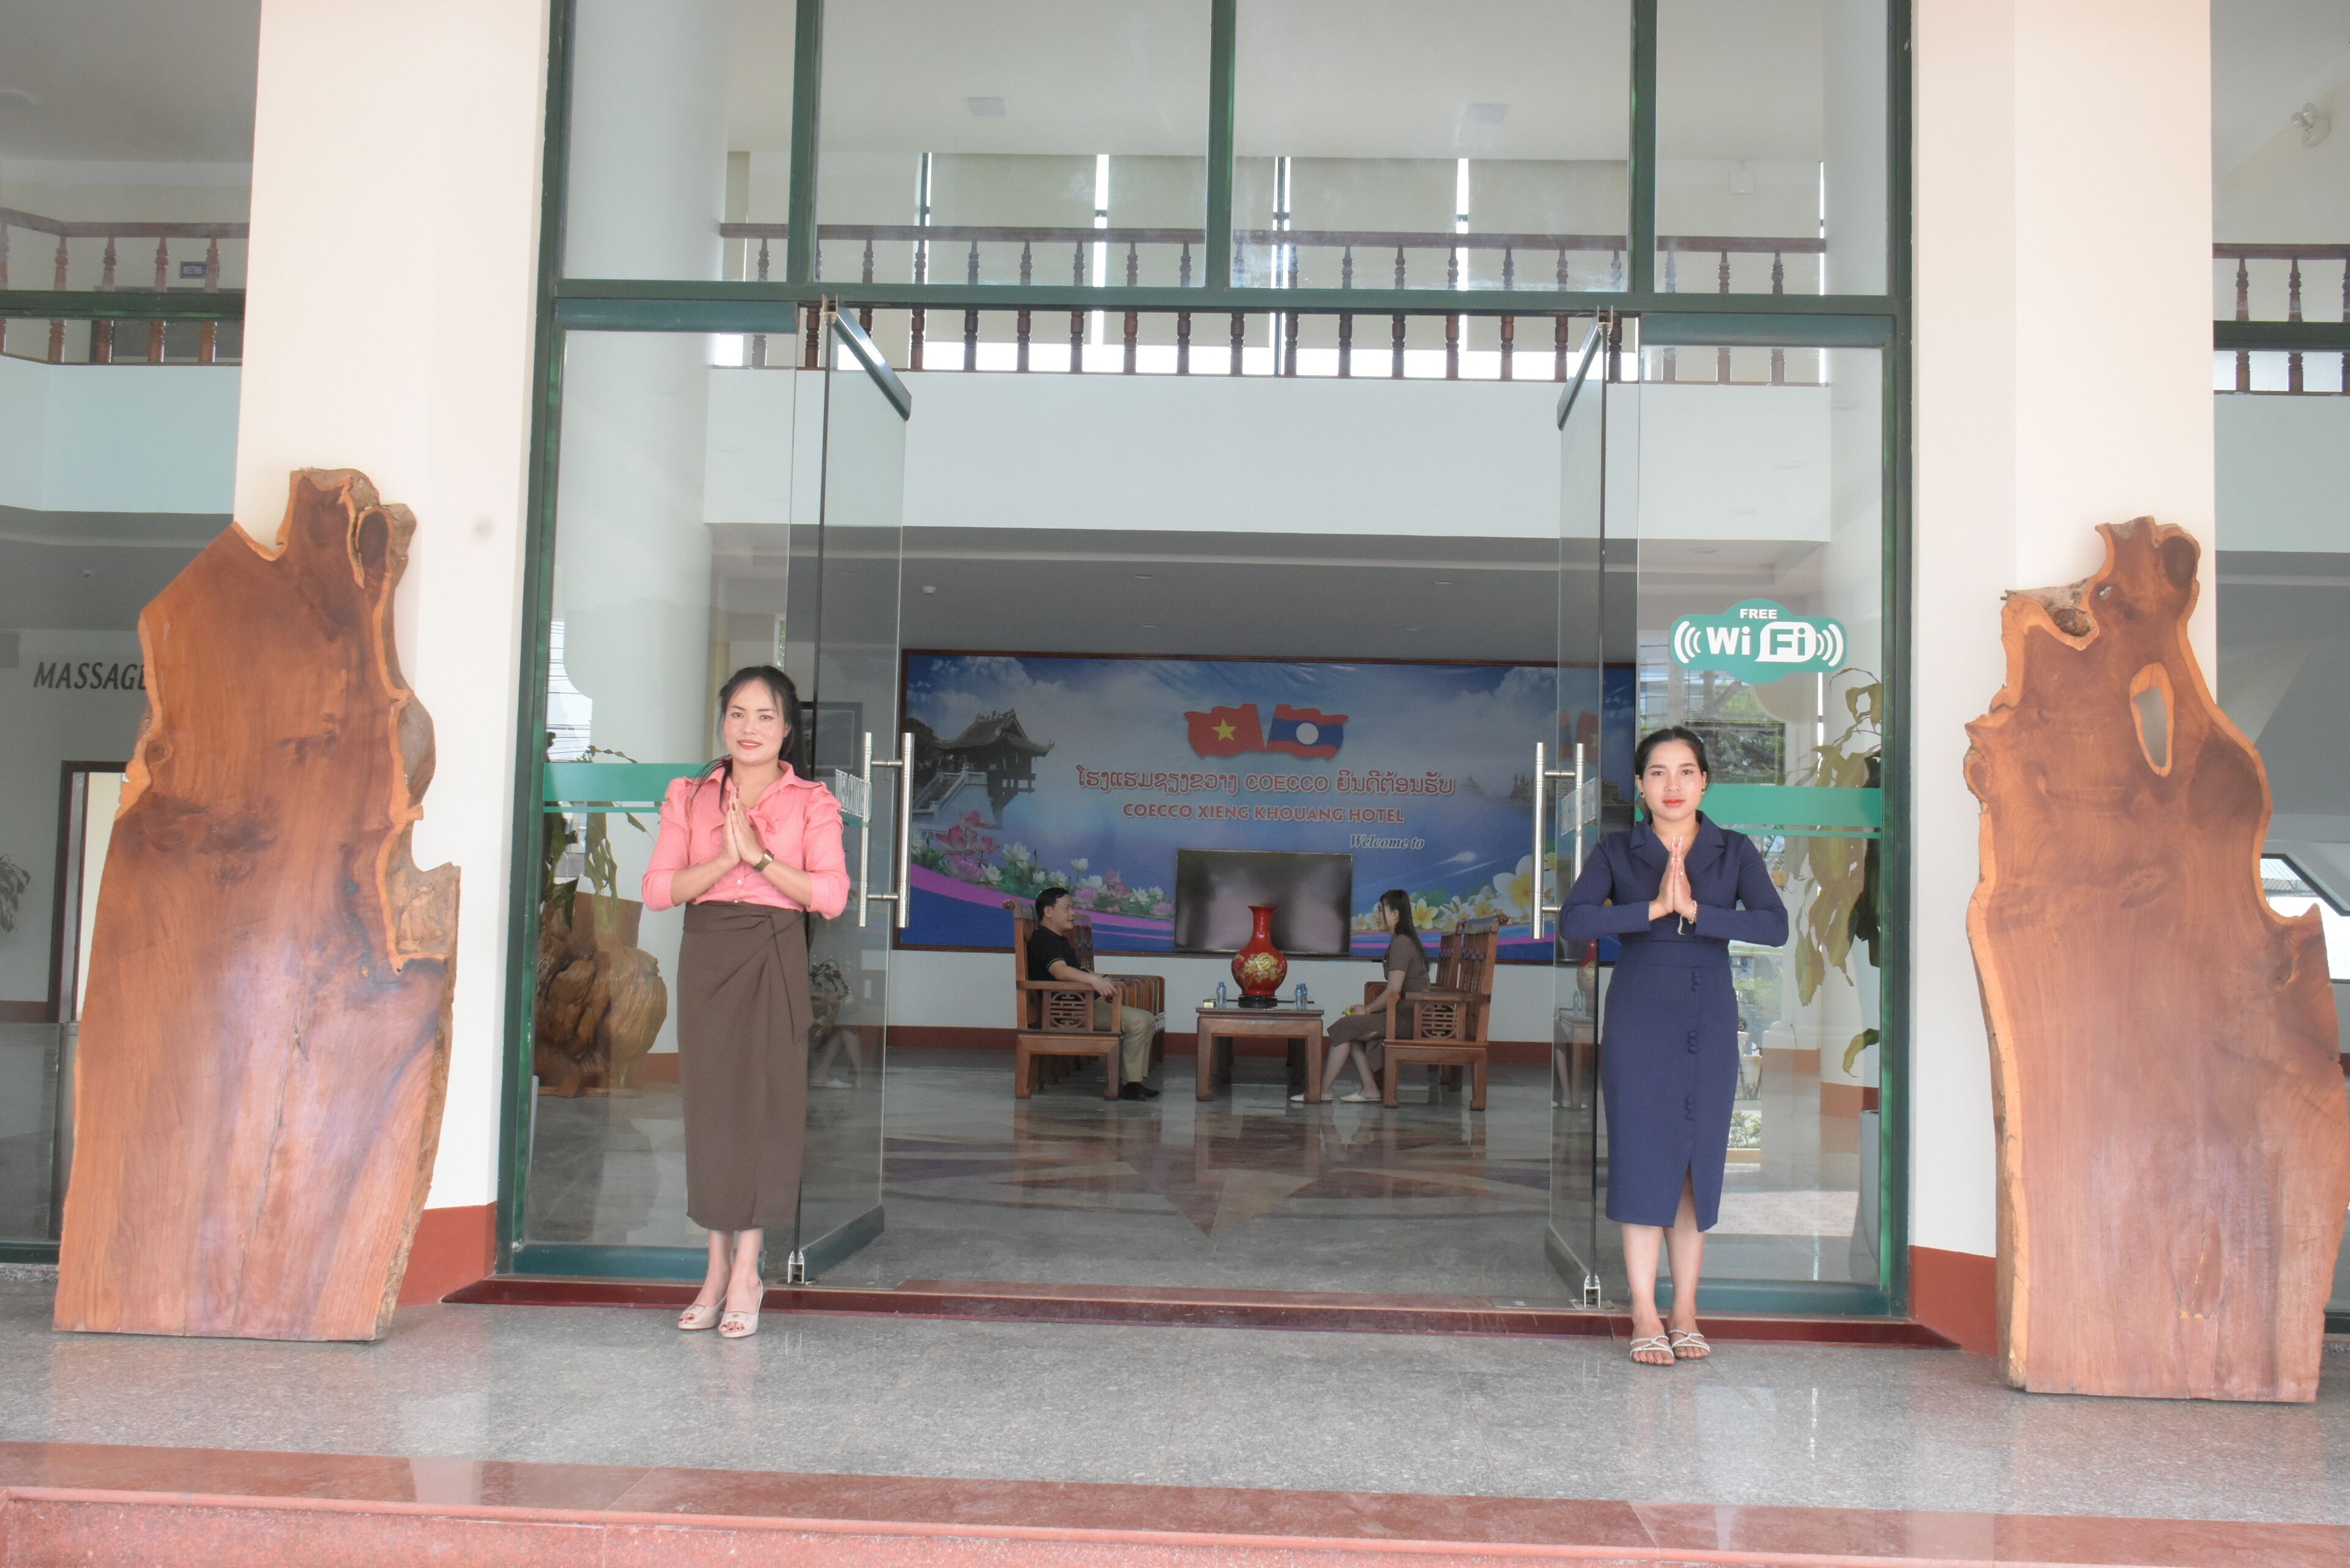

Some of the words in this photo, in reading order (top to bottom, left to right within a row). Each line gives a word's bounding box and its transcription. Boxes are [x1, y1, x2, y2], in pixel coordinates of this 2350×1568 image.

[1740, 608, 1777, 619] FREE
[1245, 774, 1329, 793] COECCO
[1122, 802, 1193, 819] COECCO
[1197, 804, 1250, 821] XIENG
[1254, 805, 1345, 822] KHOUANG
[1349, 808, 1405, 823] HOTEL
[1350, 834, 1408, 849] Welcome
[1410, 837, 1425, 849] to
